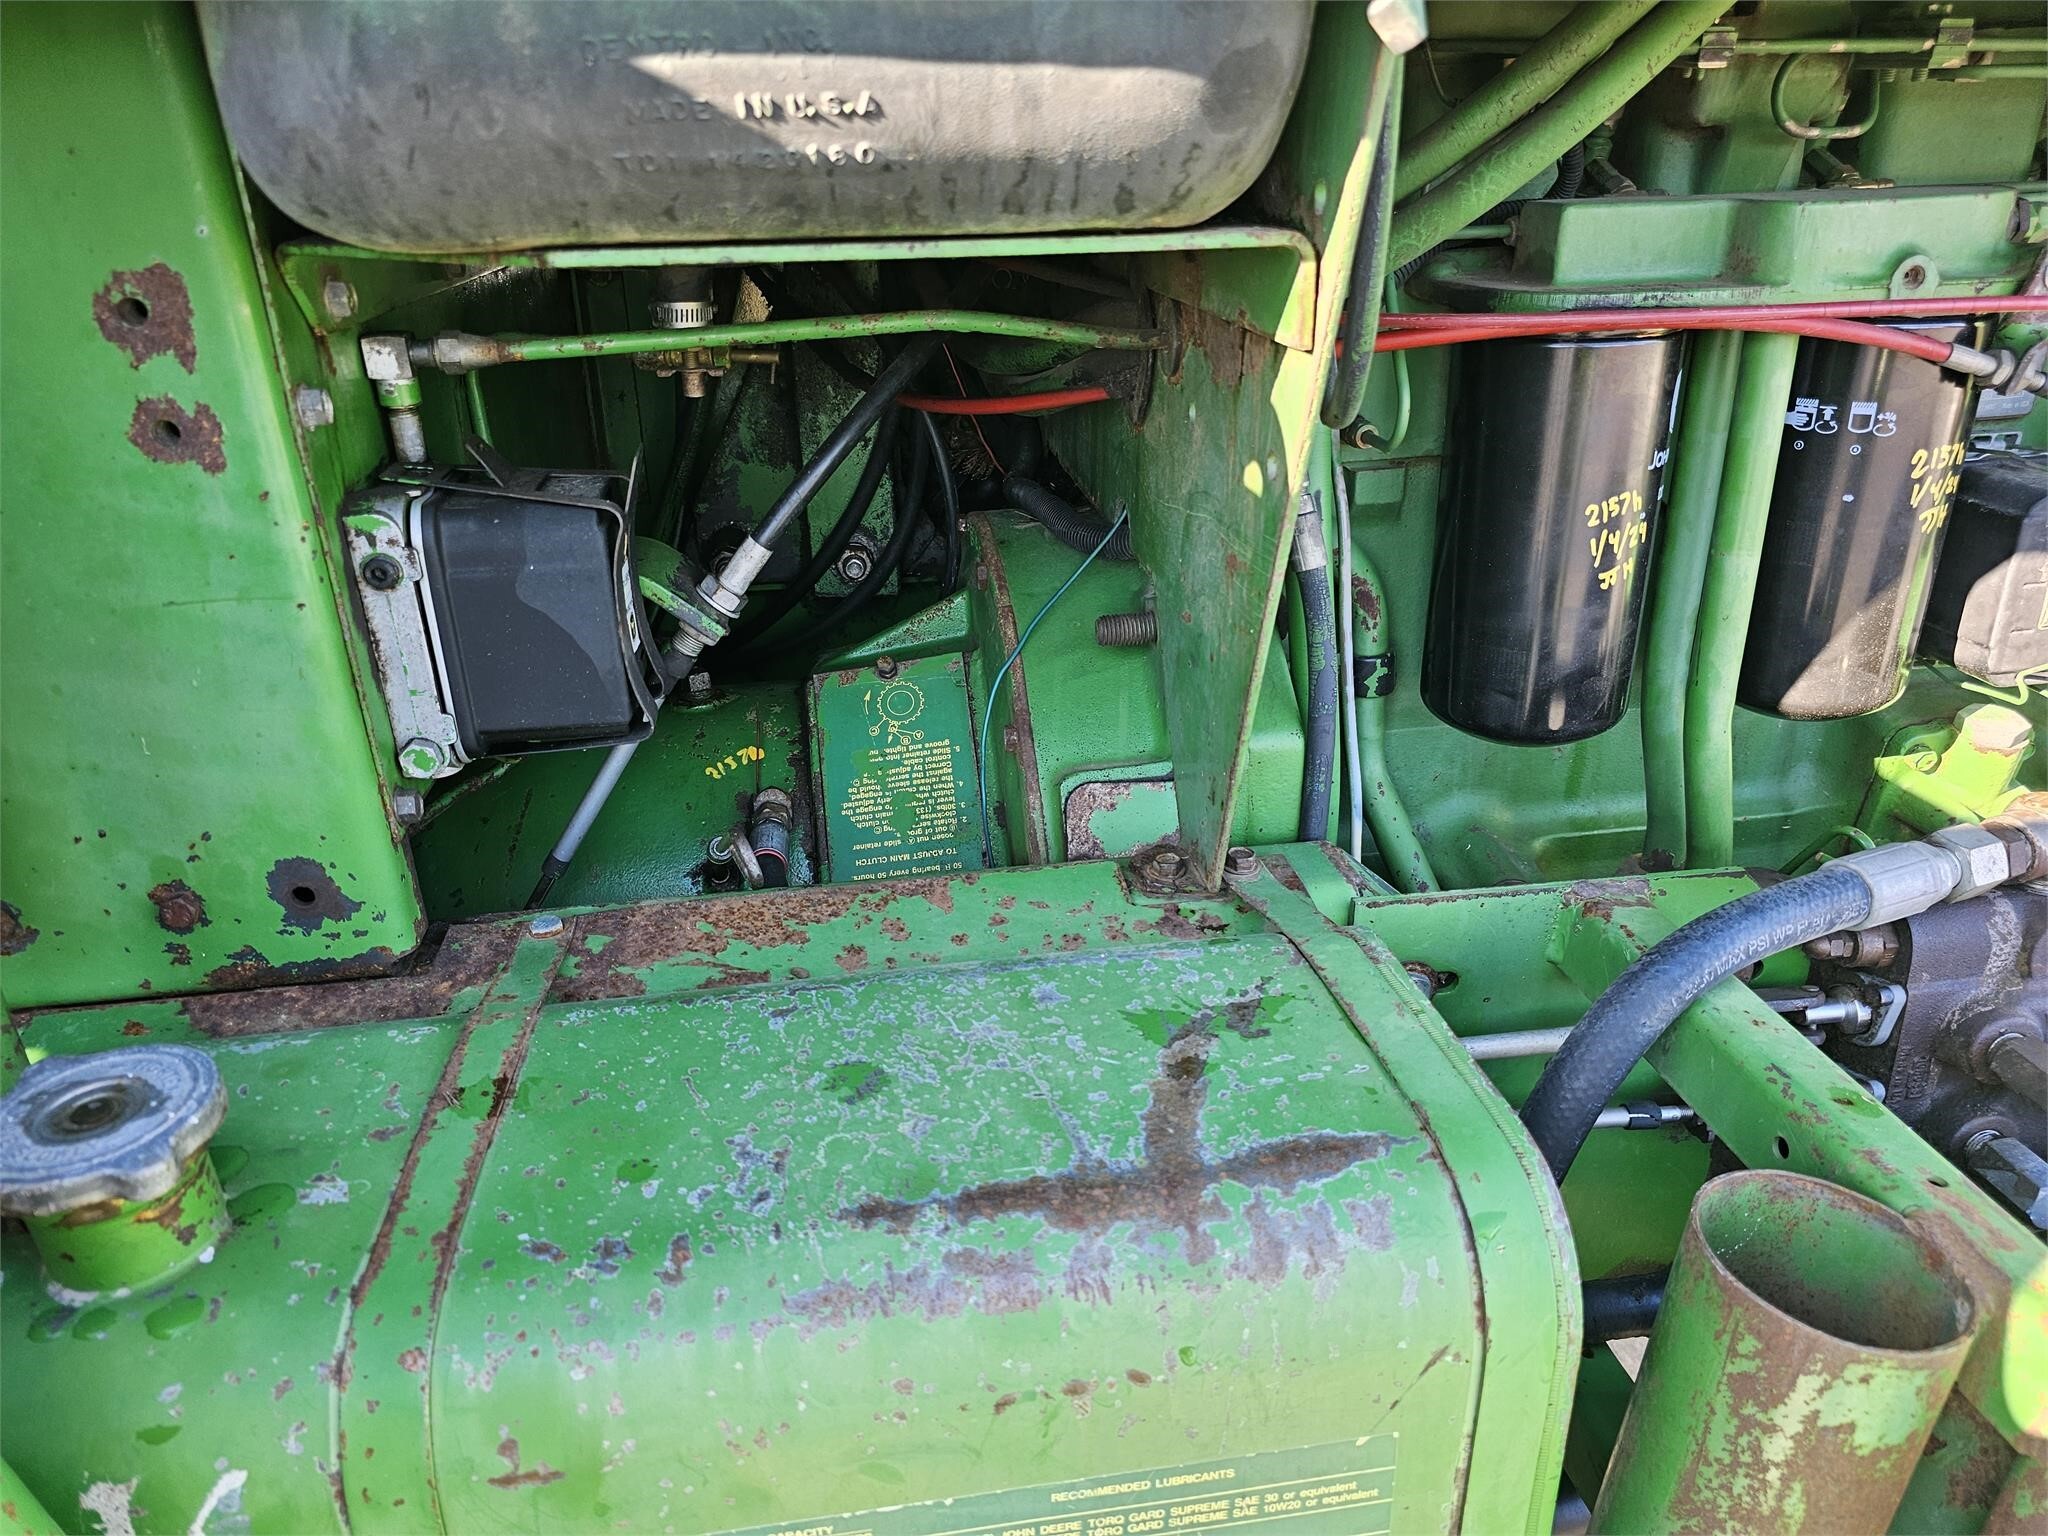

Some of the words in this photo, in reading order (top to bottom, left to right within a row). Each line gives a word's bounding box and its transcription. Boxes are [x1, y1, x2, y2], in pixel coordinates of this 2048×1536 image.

[733, 91, 774, 119] IN
[1648, 448, 1669, 470] JOH
[925, 739, 950, 748] groove
[903, 750, 930, 759] retainer
[926, 754, 951, 763] control
[925, 761, 952, 770] Correct
[926, 767, 952, 777] against
[932, 789, 954, 797] clutch
[841, 799, 874, 809] adjusted.
[856, 805, 882, 813] engage
[850, 814, 873, 822] clutch
[921, 811, 956, 819] clockwise
[854, 821, 879, 829] clutch.
[852, 842, 881, 850] retainer
[890, 854, 910, 862] MAIN
[913, 849, 943, 859] ADJUST
[856, 857, 887, 866] CLUTCH
[912, 865, 940, 873] bearing
[1716, 949, 1746, 975] MAX
[1749, 934, 1770, 955] PSI
[1050, 1479, 1151, 1503] RECOMMENDED
[1155, 1468, 1236, 1489] LUBRICANTS
[1040, 1520, 1082, 1535] DEERE
[1087, 1515, 1125, 1529] TORQ
[1128, 1509, 1165, 1523] GARD
[1170, 1500, 1230, 1517] SUPREME
[1234, 1495, 1260, 1508] SAE
[1264, 1492, 1279, 1504] 30
[1283, 1491, 1295, 1501] or
[1299, 1480, 1358, 1499] equivalent
[1087, 1525, 1123, 1536] TORQ
[1127, 1520, 1164, 1533] GARD
[1168, 1511, 1228, 1527] SUPREME
[1232, 1505, 1259, 1518] SAE
[1264, 1501, 1300, 1514] 10W20
[1305, 1498, 1318, 1507] or
[1322, 1488, 1379, 1505] equivalent
